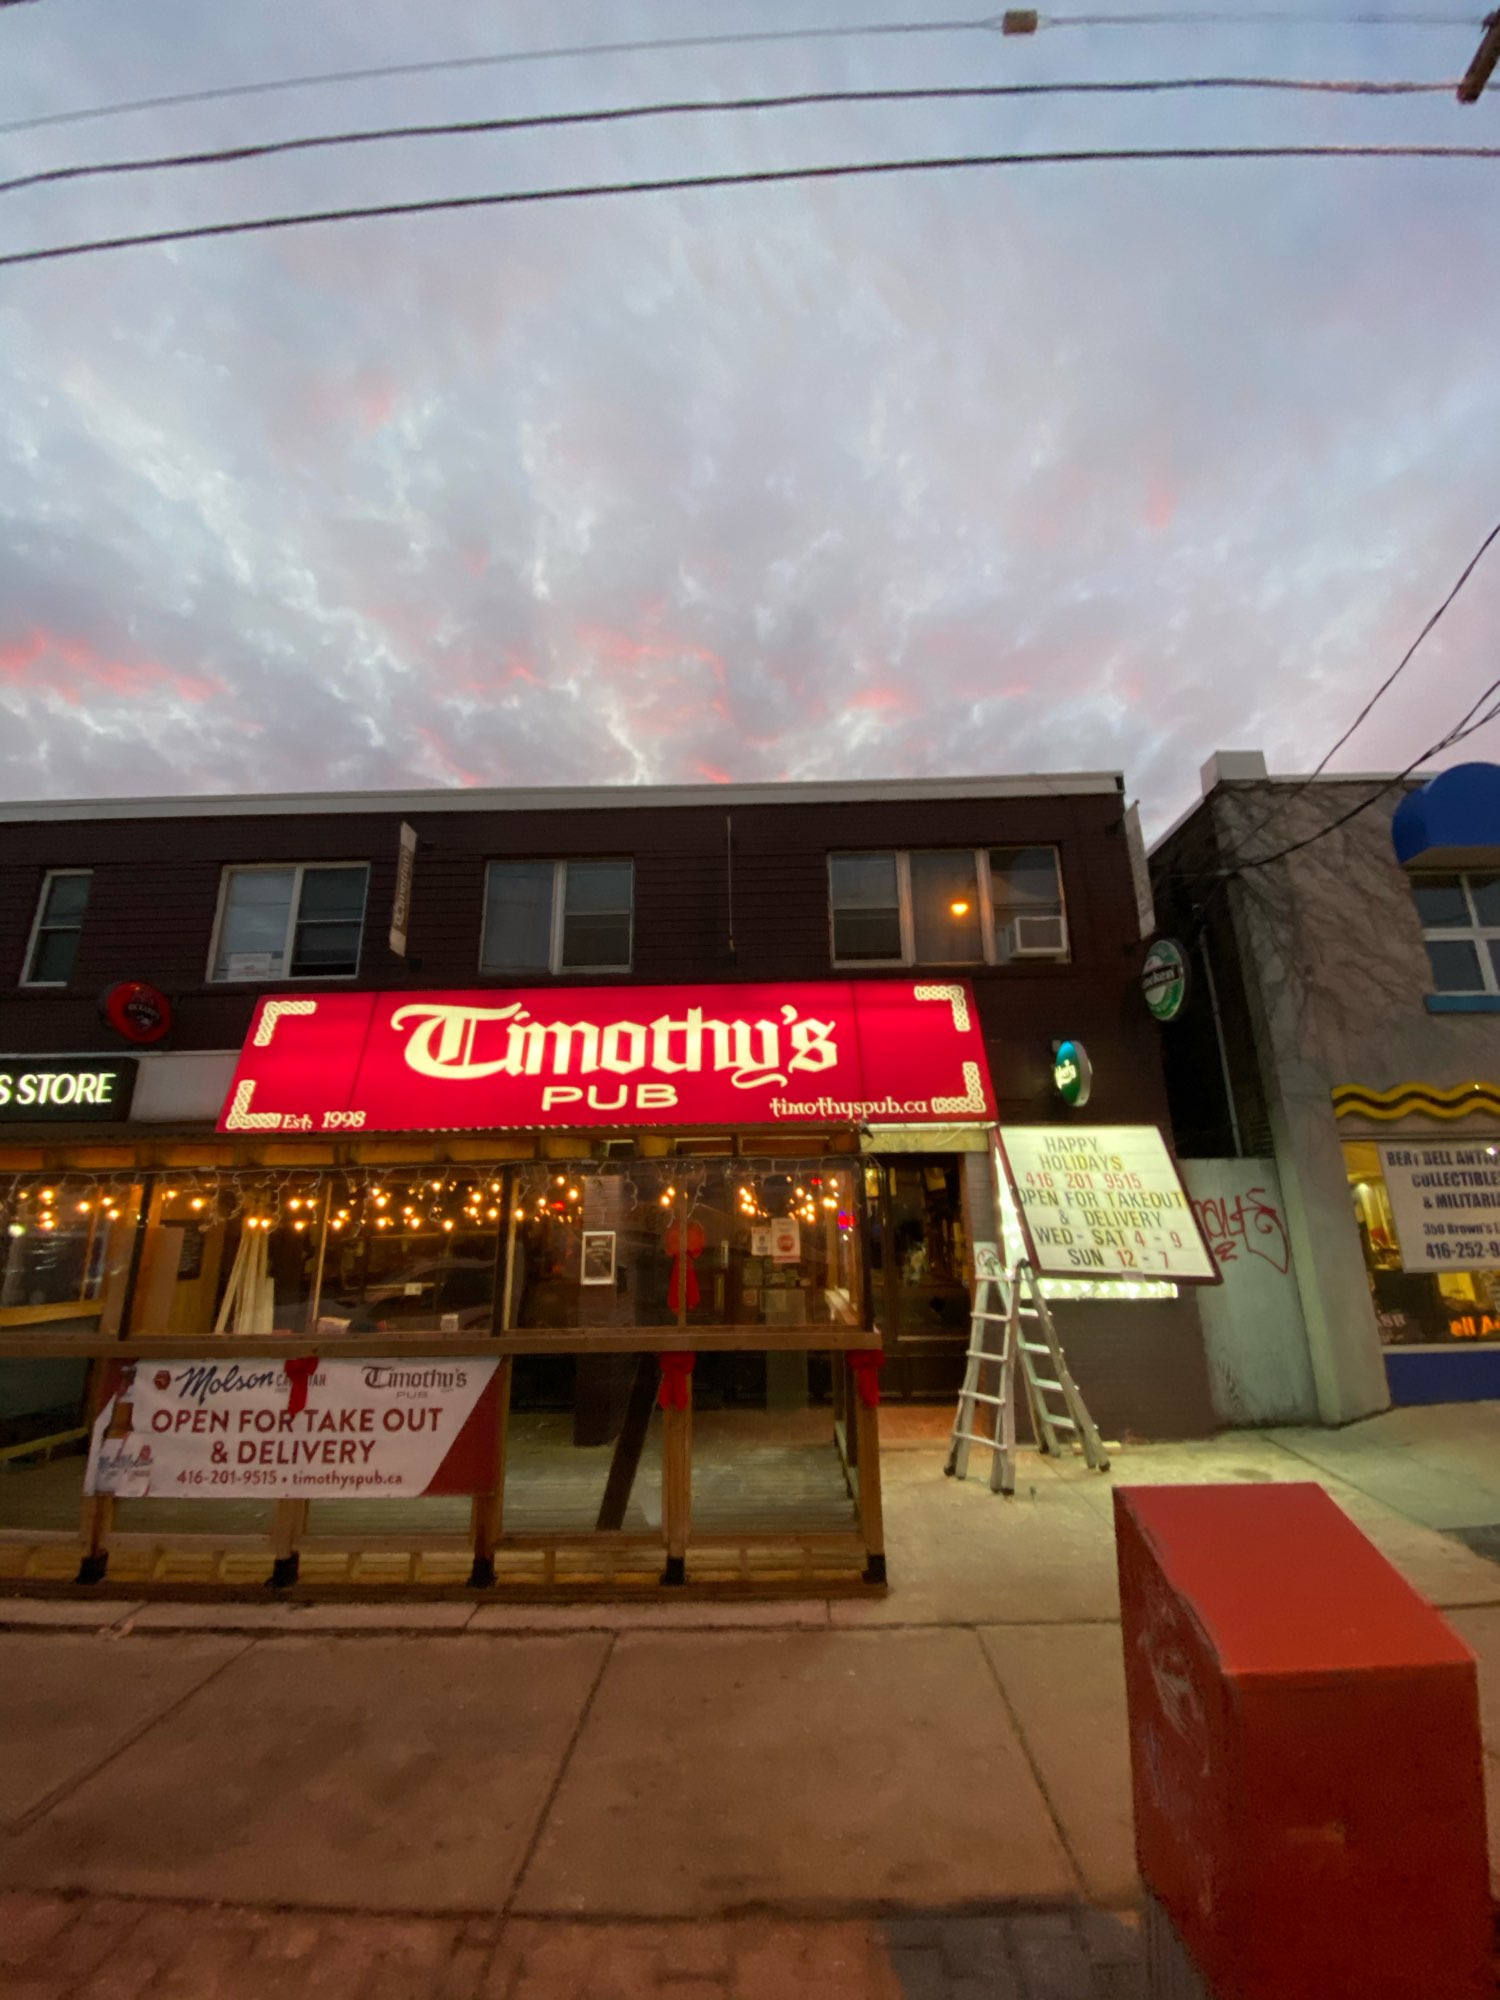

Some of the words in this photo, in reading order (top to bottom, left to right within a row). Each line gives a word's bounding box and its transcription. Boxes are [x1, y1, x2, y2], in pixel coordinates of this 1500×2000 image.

[390, 1001, 838, 1089] Timothy's
[16, 1072, 117, 1105] STORE
[541, 1083, 679, 1112] PUB
[769, 1096, 928, 1120] timothyspub.ca
[320, 1110, 367, 1129] 1998
[1043, 1136, 1099, 1154] HAPPY
[1038, 1154, 1123, 1172] HOLIDAYS
[1025, 1171, 1054, 1189] 416
[1064, 1172, 1095, 1190] 201
[1103, 1172, 1143, 1191] 9515
[1065, 1190, 1100, 1208] FOR
[1104, 1191, 1185, 1210] TAKEOUT
[1057, 1209, 1072, 1226] &
[1082, 1211, 1163, 1230] DELIVERY
[1091, 1229, 1128, 1248] SAT
[1133, 1231, 1146, 1248] 4
[1169, 1231, 1183, 1249] 9
[1067, 1249, 1105, 1267] SUN
[1115, 1249, 1139, 1269] 12
[1158, 1251, 1170, 1270] 7
[175, 1364, 275, 1406] Molson
[361, 1366, 468, 1391] Timothy's
[396, 1391, 428, 1399] PUB
[151, 1409, 229, 1433] OPEN
[239, 1409, 294, 1433] FOR
[303, 1408, 375, 1432] TAKE
[382, 1407, 443, 1432] OUT
[210, 1440, 228, 1465] &
[237, 1439, 376, 1465] DELIVERY
[176, 1470, 277, 1485] 416-201-9515
[292, 1469, 403, 1488] timothyspub.ca
